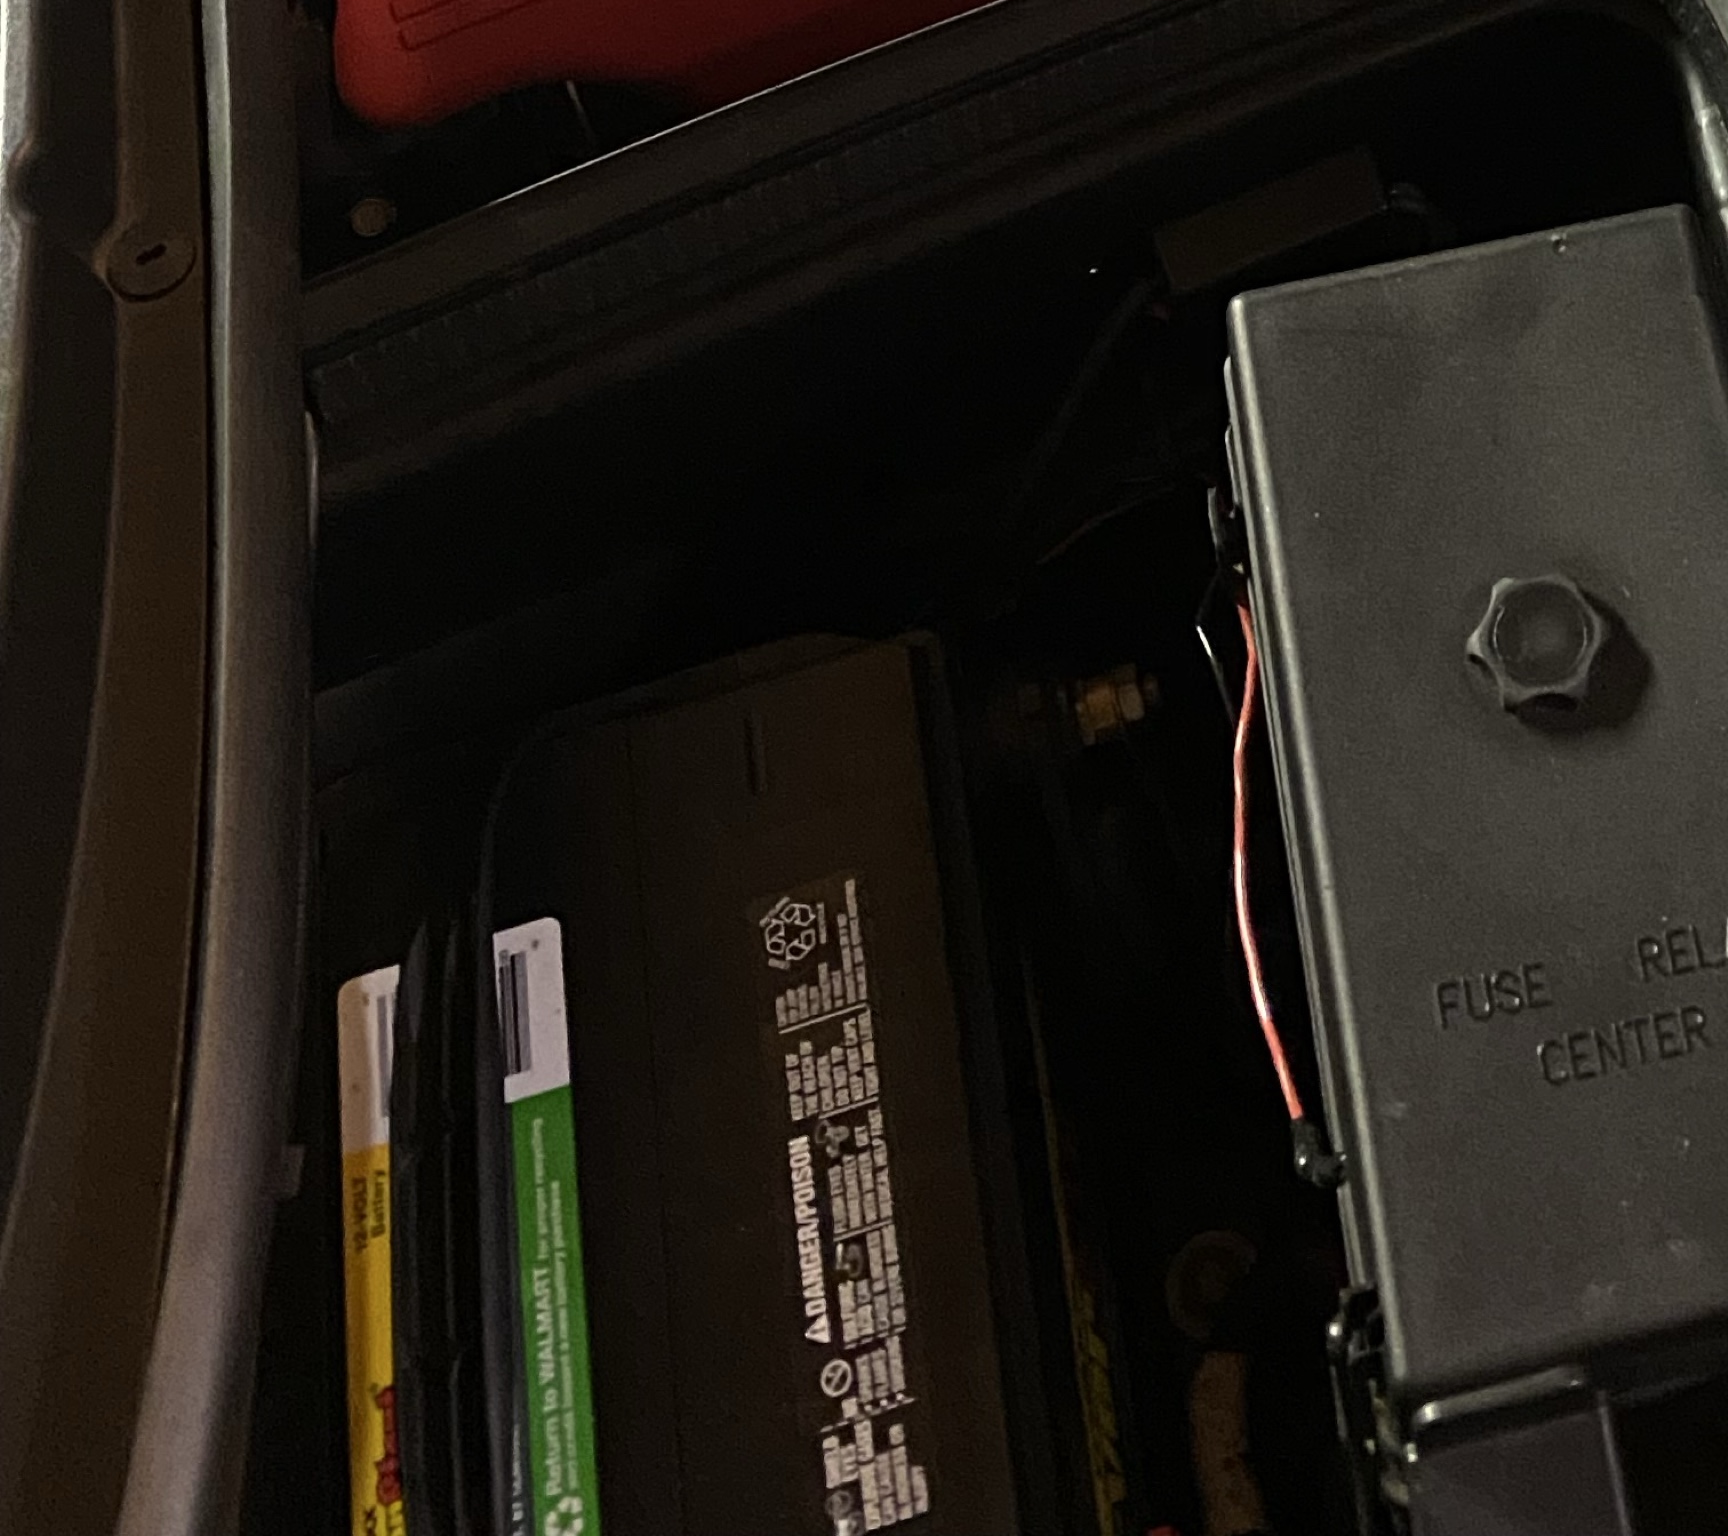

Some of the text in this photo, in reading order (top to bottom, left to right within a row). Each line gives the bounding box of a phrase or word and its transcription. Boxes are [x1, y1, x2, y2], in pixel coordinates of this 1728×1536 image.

[1434, 961, 1554, 1030] FUSE
[1536, 1005, 1713, 1087] CENTER
[351, 1176, 370, 1255] 12-VOLT
[787, 1135, 827, 1317] DANGER/POISON
[533, 1268, 554, 1387] WALMART
[543, 1388, 558, 1412] to
[544, 1417, 561, 1496] Return
